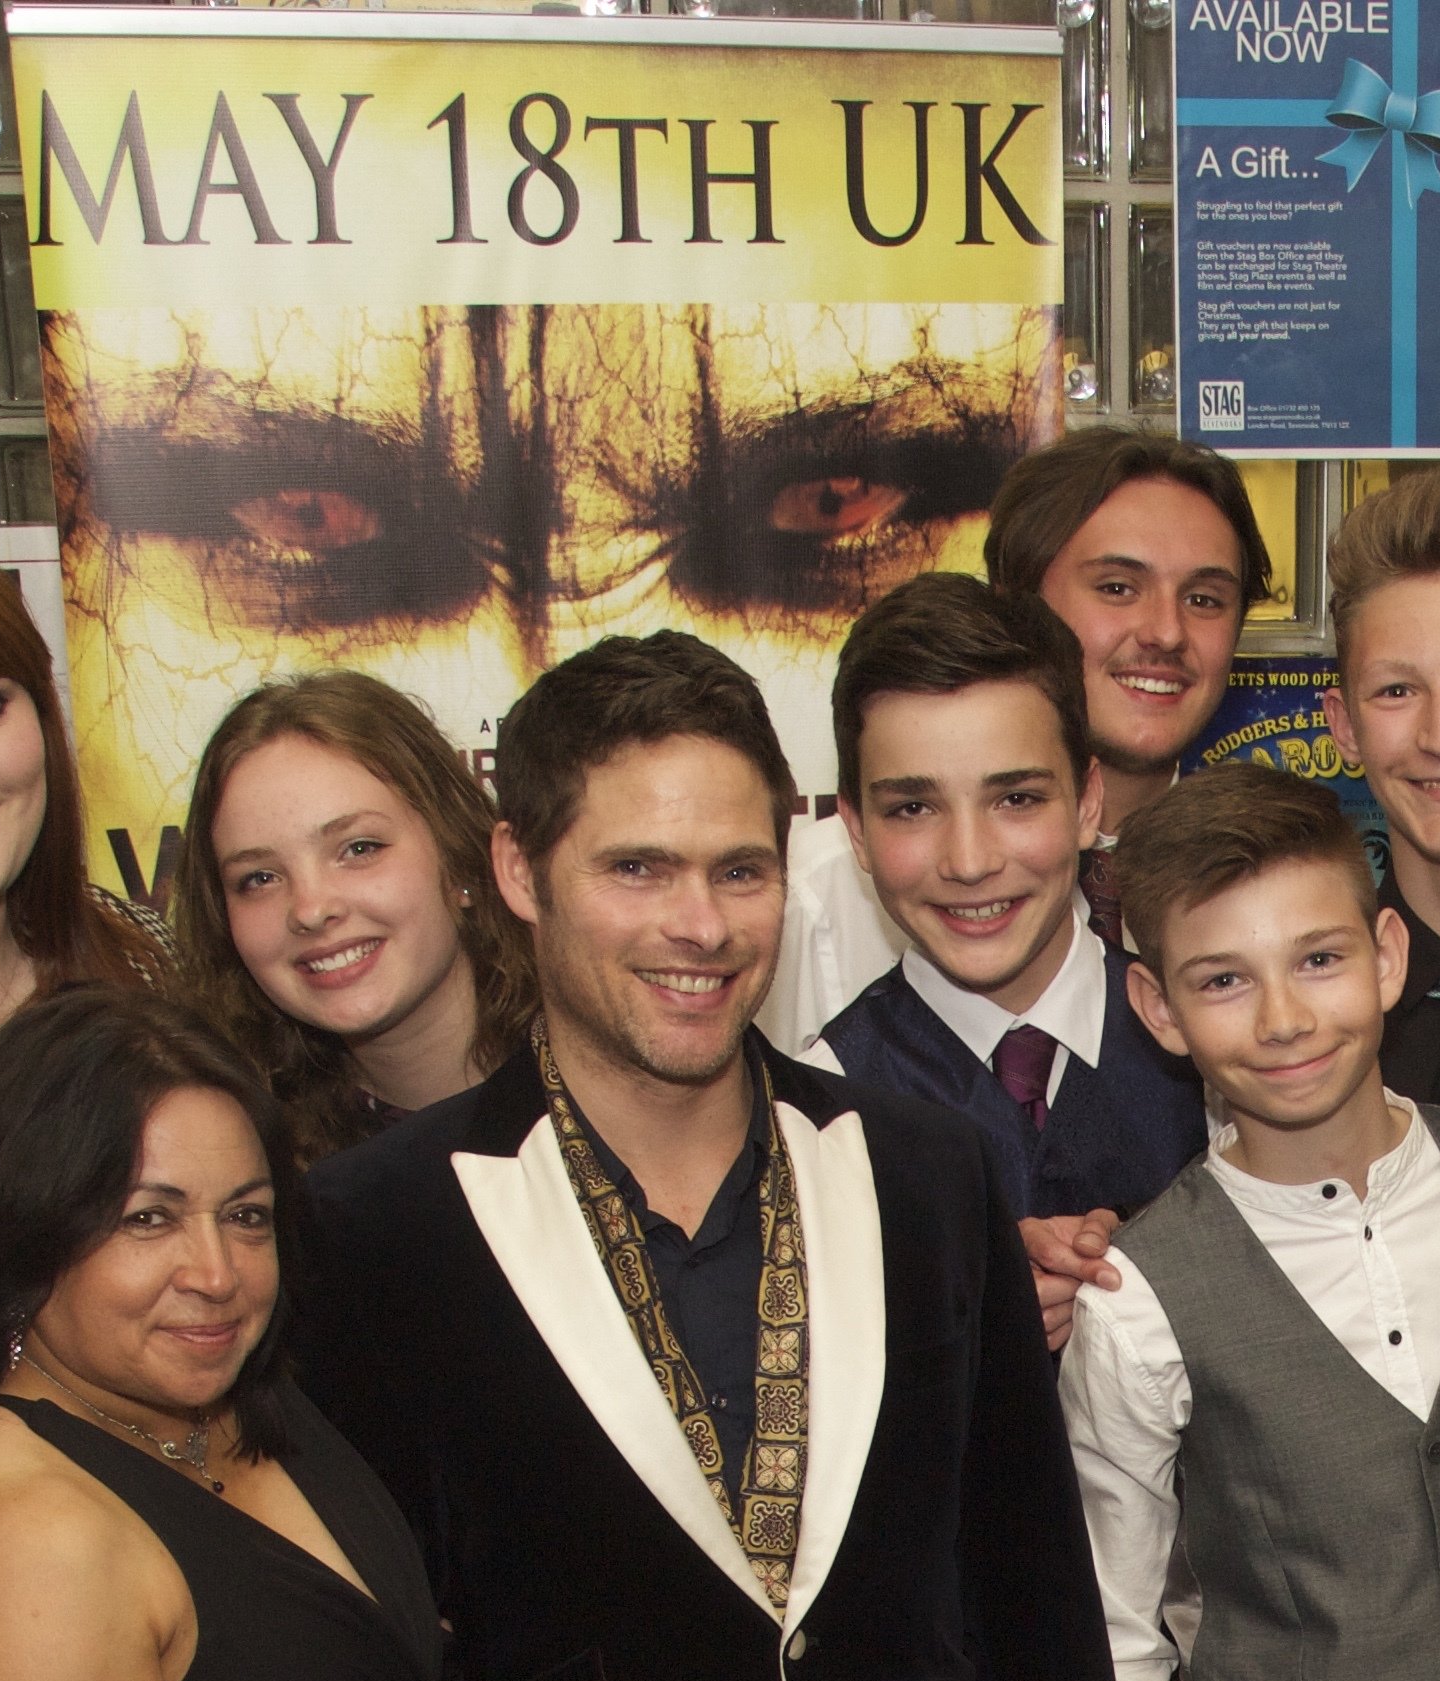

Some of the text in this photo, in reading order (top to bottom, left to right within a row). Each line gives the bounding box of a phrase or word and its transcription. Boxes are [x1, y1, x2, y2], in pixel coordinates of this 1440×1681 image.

[1189, 0, 1389, 33] AVAILABLE
[1237, 31, 1328, 63] NOW
[1195, 146, 1319, 179] A Gift...
[30, 88, 1057, 248] MAY 18TH UK
[1196, 201, 1326, 212] Struggling find that perfect
[1269, 211, 1293, 221] love?
[1215, 241, 1331, 250] vouchers available
[1237, 252, 1304, 262] Stag Office
[1228, 262, 1347, 272] exchanged Stag Theatre
[1229, 272, 1248, 282] Stag
[1251, 272, 1273, 280] Plaza
[1234, 282, 1264, 290] cinema
[1198, 301, 1275, 312] Stag vouchers
[1198, 311, 1243, 320] Christmas.
[1290, 322, 1316, 332] keeps
[1198, 332, 1224, 342] giving
[1202, 385, 1240, 416] STAG
[1229, 673, 1265, 686] ETTS
[1268, 673, 1308, 686] WOOD
[1203, 713, 1308, 765] RODGERS &
